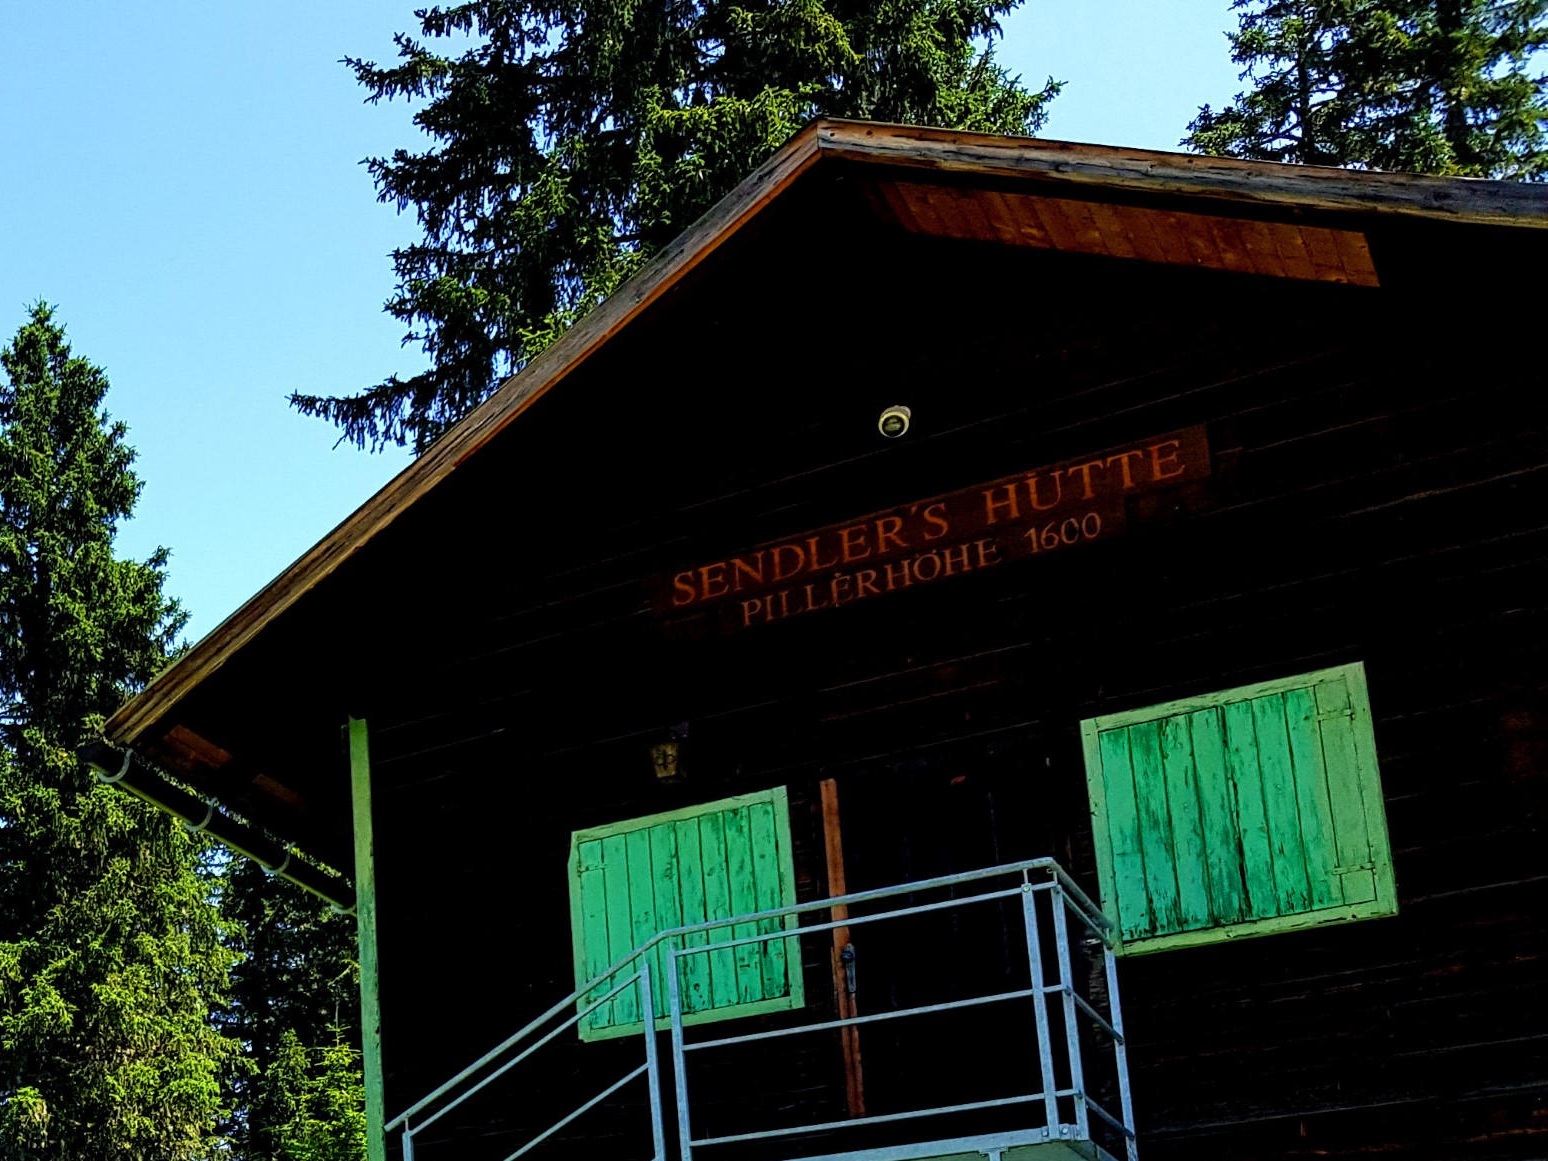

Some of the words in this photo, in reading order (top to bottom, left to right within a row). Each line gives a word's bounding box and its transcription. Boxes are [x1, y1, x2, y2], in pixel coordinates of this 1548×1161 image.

[982, 440, 1186, 526] HÜTTE
[740, 537, 1003, 628] PILLERHÖHE
[1023, 512, 1103, 554] 1600
